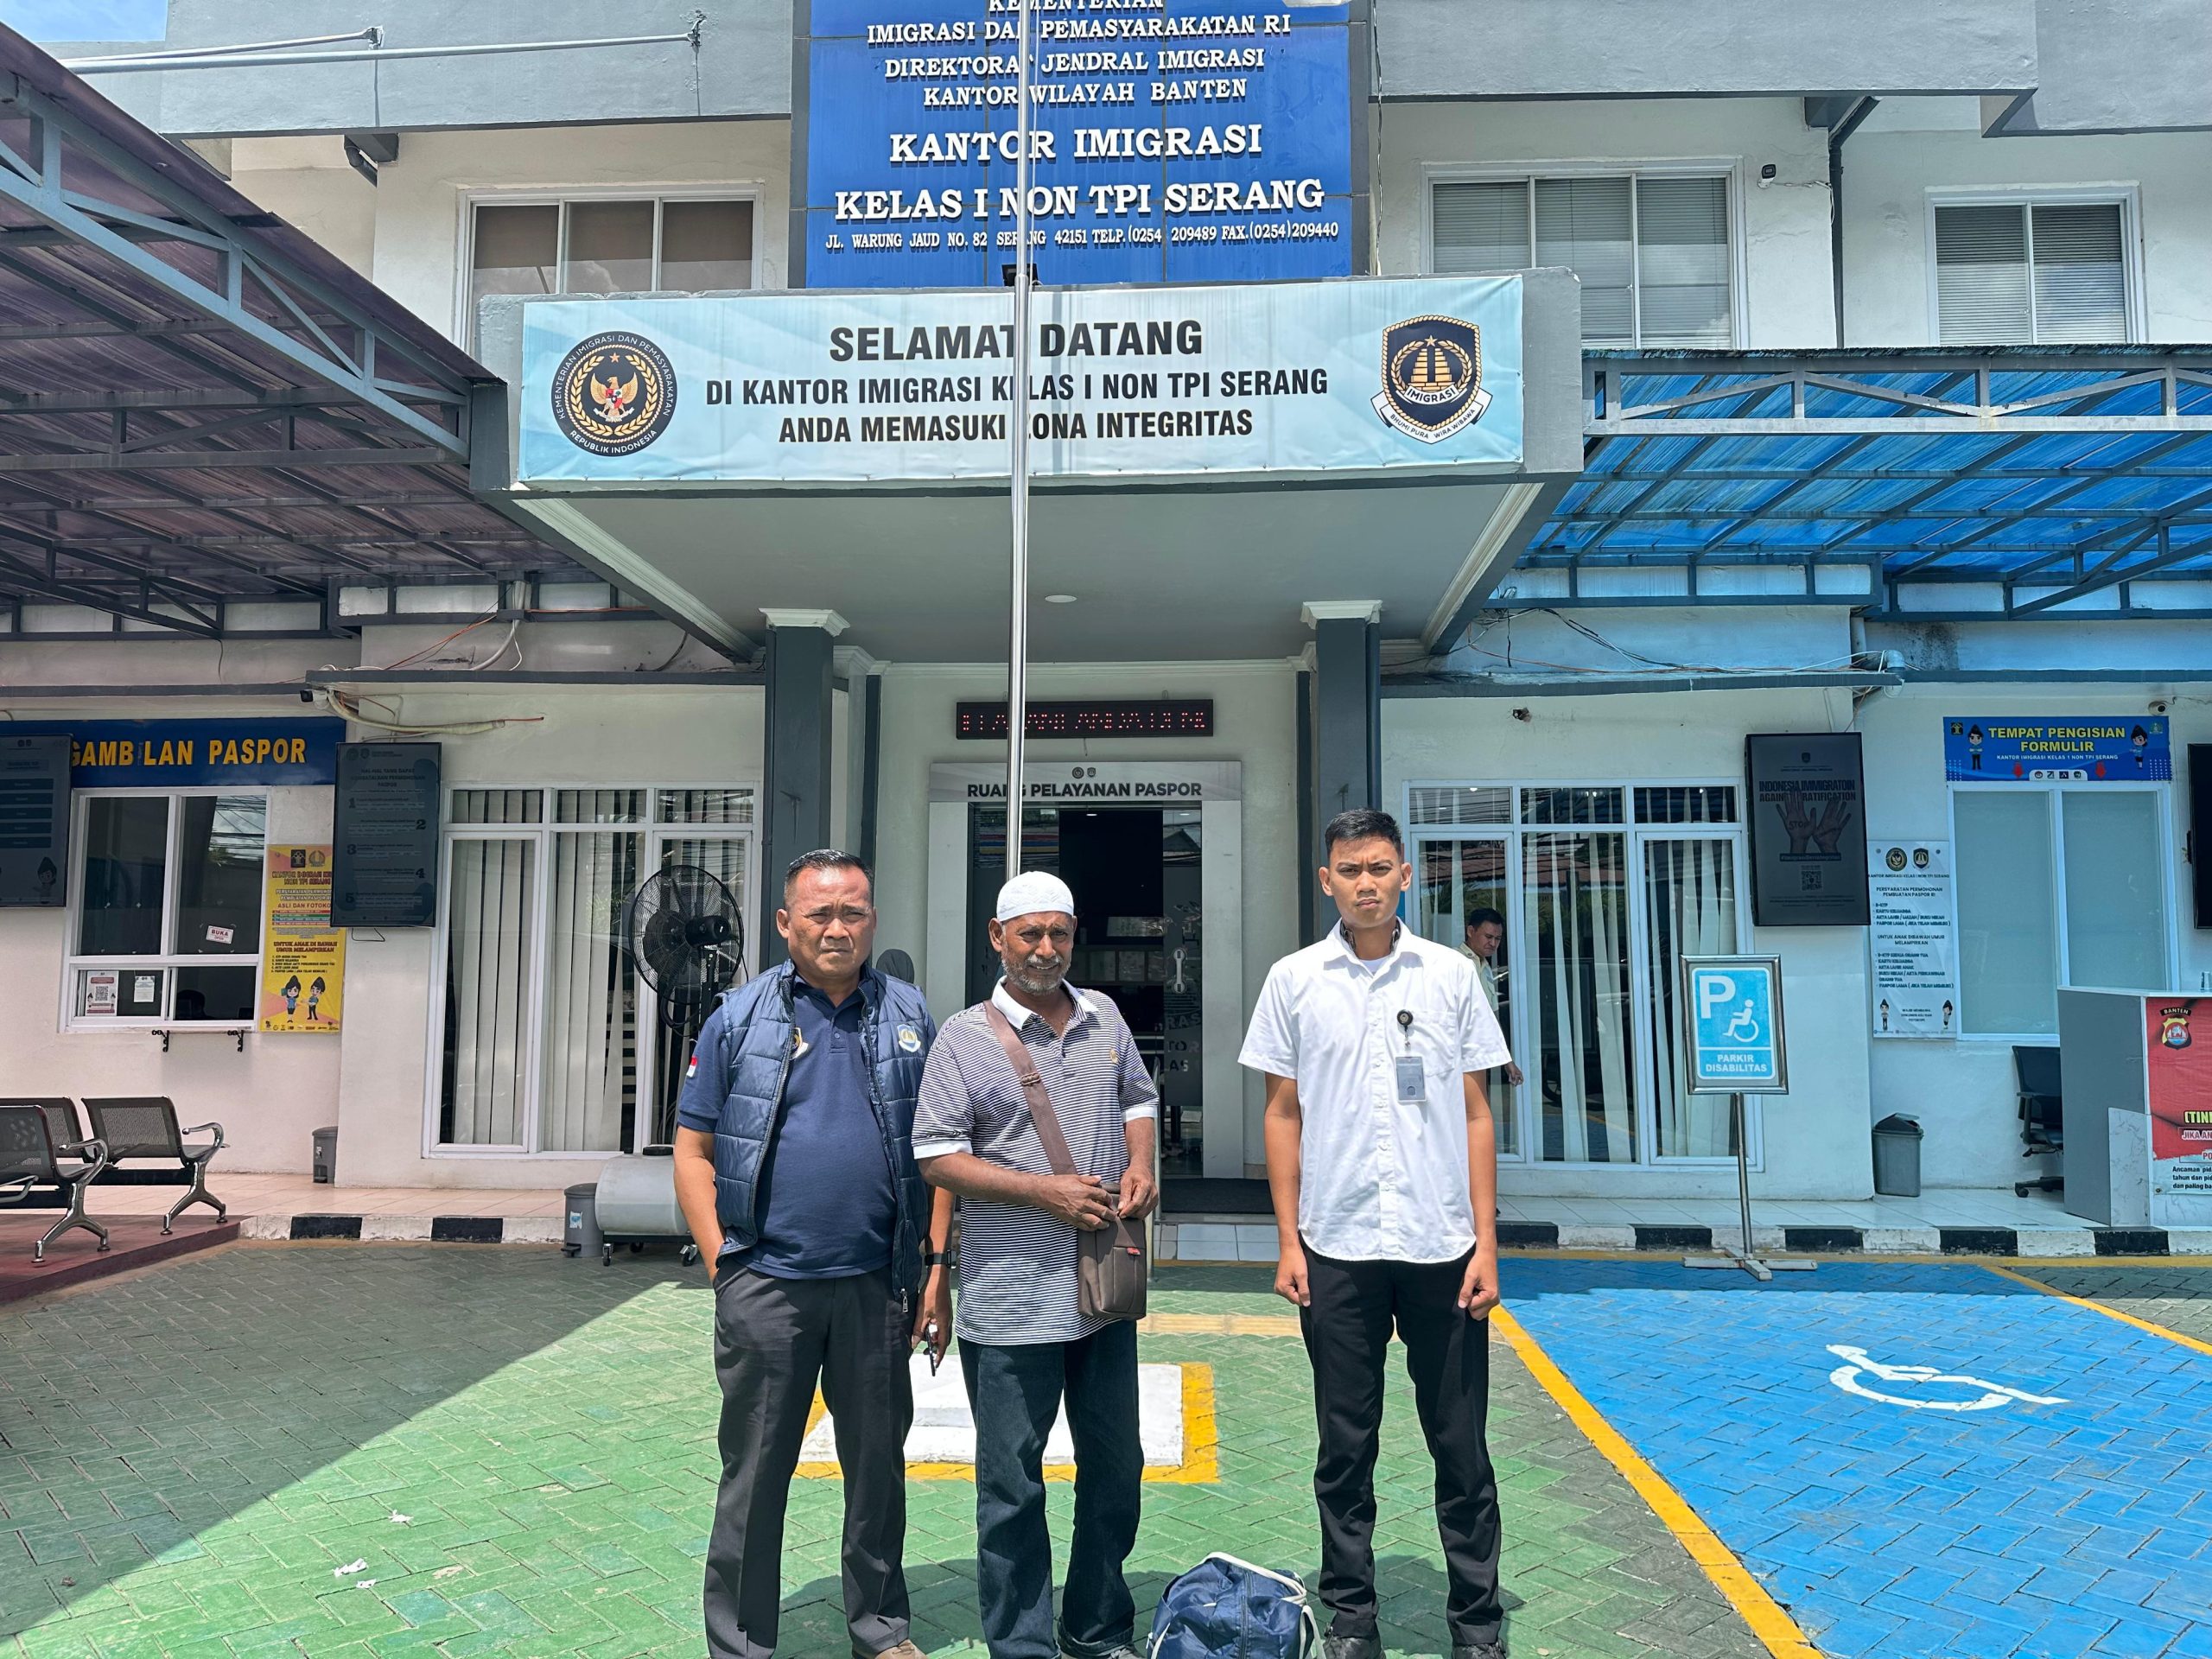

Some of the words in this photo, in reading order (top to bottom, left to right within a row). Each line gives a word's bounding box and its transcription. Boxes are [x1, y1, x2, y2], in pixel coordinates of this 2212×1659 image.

[868, 22, 976, 43] IMIGRASI
[985, 22, 1020, 40] DA
[1041, 16, 1255, 38] PEMASYARAKATAN
[1264, 15, 1291, 34] RI
[885, 55, 1033, 78] DIREKTORA
[1041, 52, 1149, 73] JENDRAL
[1158, 48, 1264, 70] IMIGRASI
[924, 87, 1019, 106] KANTOR
[1029, 84, 1135, 104] WILAYAH
[1151, 79, 1247, 101] BANTEN
[890, 130, 1056, 162] KANTOR
[1074, 124, 1262, 157] IMIGRASI
[835, 189, 962, 220] KELAS
[973, 189, 988, 217] I
[999, 186, 1078, 216] NON
[1089, 184, 1151, 214] TPI
[1165, 179, 1325, 213] SERANG
[826, 234, 844, 248] JL.
[852, 233, 903, 248] WARUNG
[909, 232, 940, 247] JAUD
[947, 232, 969, 246] NO.
[972, 232, 988, 245] 82
[996, 232, 1046, 245] SERNG
[1054, 229, 1088, 244] 42151
[1171, 226, 1217, 242] 209489
[830, 323, 1014, 362] SELAMAT
[1040, 320, 1202, 357] DATANG
[555, 355, 578, 420] KEMENTERIAN
[575, 334, 615, 358] IMIGRASI
[618, 334, 638, 345] DAN
[639, 340, 673, 416] PEMASYARAKATAN
[706, 380, 732, 404] DI
[743, 378, 849, 404] KANTOR
[858, 375, 981, 404] IMIGRASI
[993, 373, 1074, 401] KLAS
[1084, 374, 1091, 399] I
[1103, 373, 1157, 400] NON
[1167, 372, 1210, 398] TPI
[1220, 368, 1327, 397] SERANG
[1407, 387, 1456, 403] IMIGRASI
[779, 416, 851, 442] ANDA
[861, 414, 1005, 442] MEMASUKI
[1028, 413, 1087, 440] ONA
[1097, 409, 1253, 438] INTEGRITAS
[1389, 414, 1409, 431] BHUMI
[1411, 428, 1429, 439] PURA
[1433, 426, 1452, 439] WIRA
[1452, 409, 1475, 429] WIBAWA
[570, 429, 608, 454] REPUBLIK
[611, 429, 657, 454] INDONESIA
[1988, 728, 2043, 739] TEMPAT
[2048, 727, 2126, 738] PENGISIAN
[209, 739, 306, 765] PASPOR
[2020, 741, 2094, 752] FORMULIR
[1031, 783, 1130, 797] PELAYANAN
[1135, 782, 1202, 796] PASPOR
[416, 819, 426, 830] 2
[346, 844, 356, 855] 3
[1699, 975, 1736, 1019] P
[1706, 1064, 1768, 1072] DISABILITAS
[1717, 1054, 1754, 1063] PARKIR
[2183, 1130, 2200, 1139] JIKA
